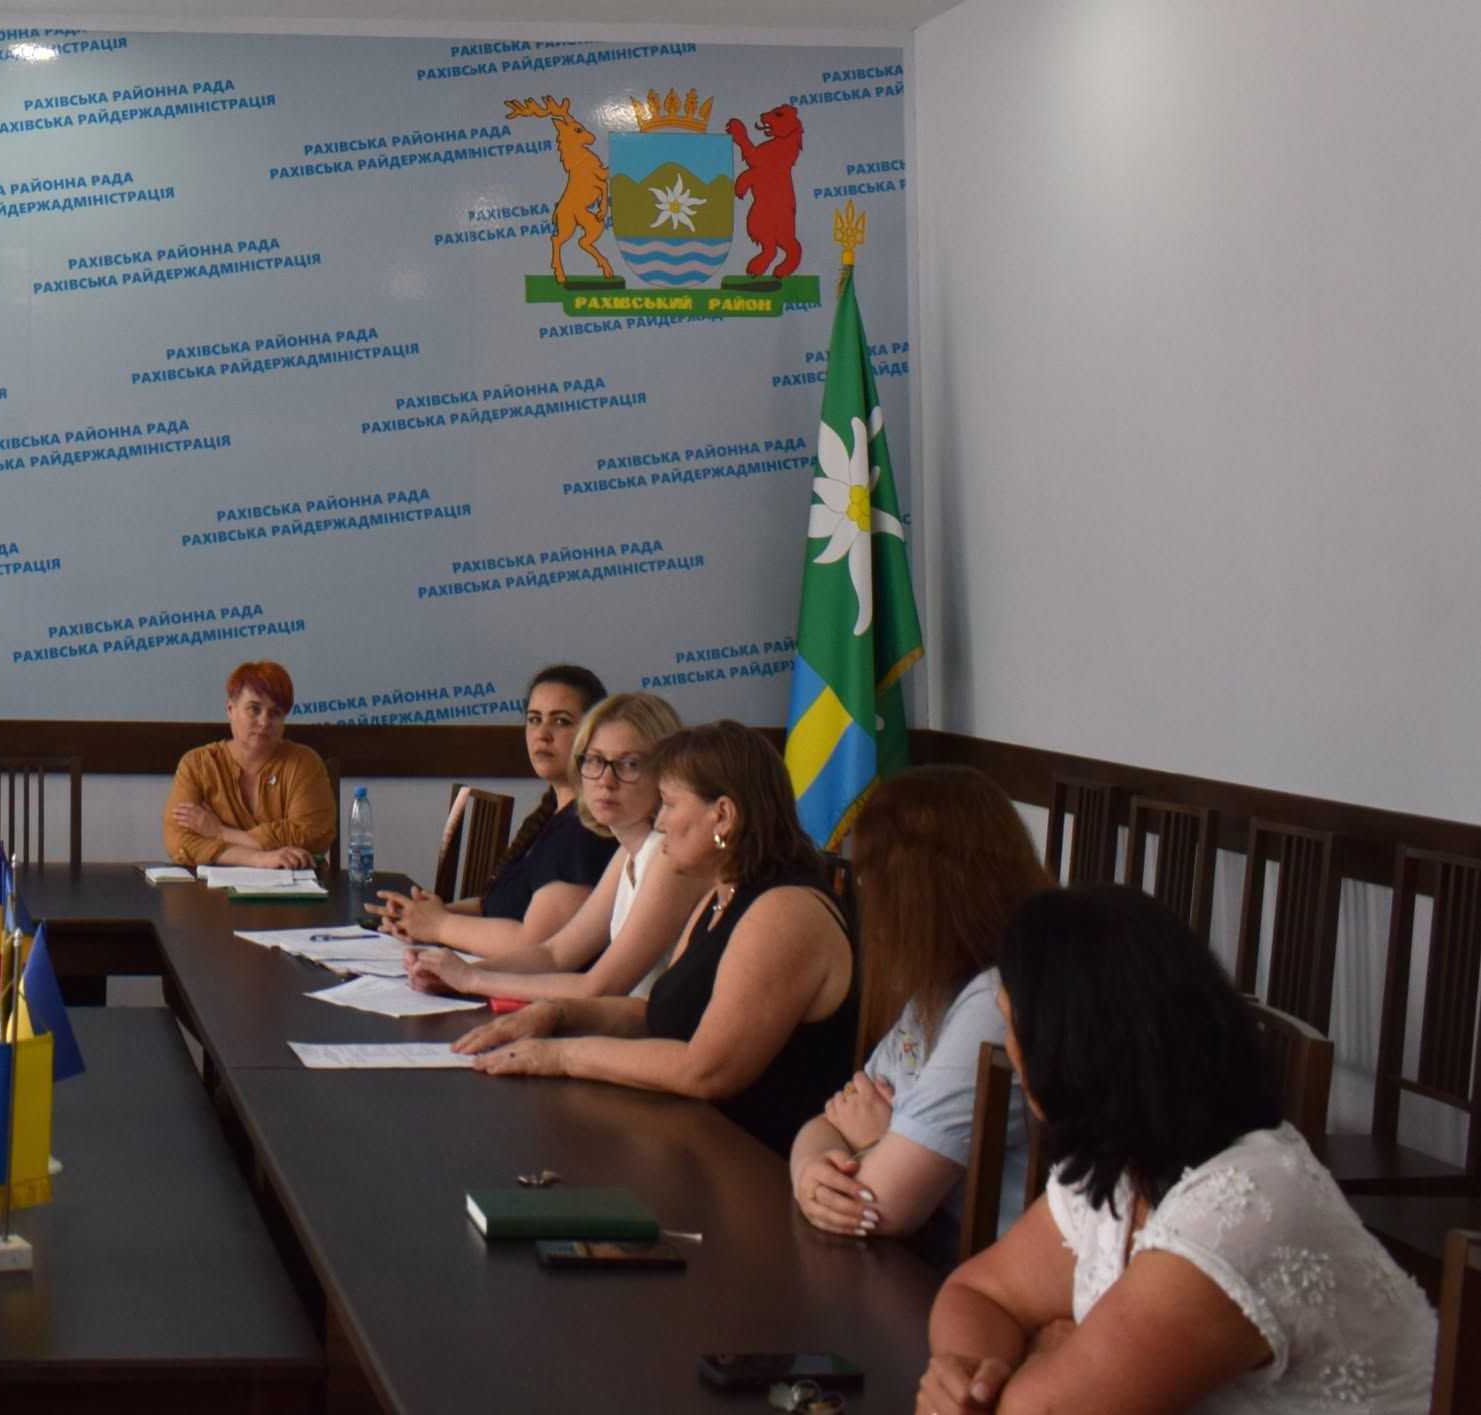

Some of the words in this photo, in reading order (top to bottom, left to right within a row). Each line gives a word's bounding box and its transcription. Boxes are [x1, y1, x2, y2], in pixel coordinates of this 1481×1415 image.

[417, 62, 498, 81] РАХІВСЬКА
[501, 42, 697, 72] РАЙДЕРЖАДМІНІСТРАЦІЯ
[822, 65, 904, 83] РАХІВСЬКА
[24, 92, 108, 111] РАХІВСЬКА
[112, 84, 188, 102] РАЙОННА
[192, 79, 235, 95] РАДА
[77, 94, 276, 125] РАЙДЕРЖАДМІНІСТРАЦІЯ
[789, 87, 872, 106] РАХІВСЬКА
[304, 137, 387, 156] РАХІВСЬКА
[392, 129, 467, 147] РАЙОННА
[470, 125, 511, 140] РАДА
[269, 160, 354, 180] РАХІВСЬКА
[357, 139, 552, 171] РАЙДЕРЖАДМІНІСТРАЦІЯ
[10, 176, 87, 195] РАЙОННА
[91, 171, 134, 187] РАДА
[813, 180, 896, 199] РАХІВСЬКА
[468, 203, 551, 221] РАХІВСЬКА
[434, 226, 516, 246] РАХІВСЬКА
[68, 250, 153, 270] РАХІВСЬКА
[157, 242, 233, 261] РАЙОННА
[237, 237, 280, 254] РАДА
[33, 274, 118, 294] РАХІВСЬКА
[122, 252, 321, 285] РАЙДЕРЖАДМІНІСТРАЦІЯ
[574, 294, 692, 310] РАХІВСЬКИЙ
[708, 295, 772, 311] РАЙОН
[166, 340, 251, 361] РАХІВСЬКА
[255, 332, 332, 351] РАЙОННА
[335, 327, 378, 343] РАДА
[539, 319, 622, 339] РАХІВСЬКА
[131, 365, 216, 385] РАХІВСЬКА
[220, 342, 420, 375] РАЙДЕРЖАДМІНІСТРАЦІЯ
[396, 390, 479, 410] РАХІВСЬКА
[482, 382, 559, 401] РАЙОННА
[563, 377, 606, 393] РАДА
[361, 415, 446, 434] РАХІВСЬКА
[449, 392, 647, 425] РАЙДЕРЖАДМІНІСТРАЦІЯ
[65, 424, 143, 444] РАЙОННА
[146, 419, 189, 436] РАДА
[30, 434, 231, 467] РАЙДЕРЖАДМІНІСТРАЦІЯ
[597, 451, 681, 471] РАХІВСЬКА
[685, 442, 760, 461] РАЙОННА
[764, 436, 807, 453] РАДА
[563, 475, 647, 495] РАХІВСЬКА
[651, 456, 819, 485] РАЙДЕРЖАДМІНІСТРА
[216, 502, 302, 522] РАХІВСЬКА
[306, 493, 383, 513] РАЙОННА
[387, 488, 430, 505] РАДА
[182, 526, 267, 547] РАХІВСЬКА
[271, 503, 472, 536] РАЙДЕРЖАДМІНІСТРАЦІЯ
[452, 553, 536, 574] РАХІВСЬКА
[540, 544, 617, 564] РАЙОННА
[620, 540, 663, 556] РАДА
[417, 578, 502, 599] РАХІВСЬКА
[505, 555, 704, 589] РАЙДЕРЖАДМІНІСТРАЦІЯ
[48, 618, 134, 638] РАХІВСЬКА
[138, 609, 216, 628] РАЙОННА
[220, 603, 264, 620] РАДА
[12, 642, 99, 663] РАХІВСЬКА
[103, 619, 305, 653] РАЙДЕРЖАДМІНІСТРАЦІЯ
[676, 644, 759, 664] РАХІВСЬКА
[641, 668, 726, 689] РАХІВСЬКА
[291, 696, 368, 716] АХІВСЬКА
[372, 687, 450, 707] РАЙОННА
[453, 681, 496, 699] РАДА
